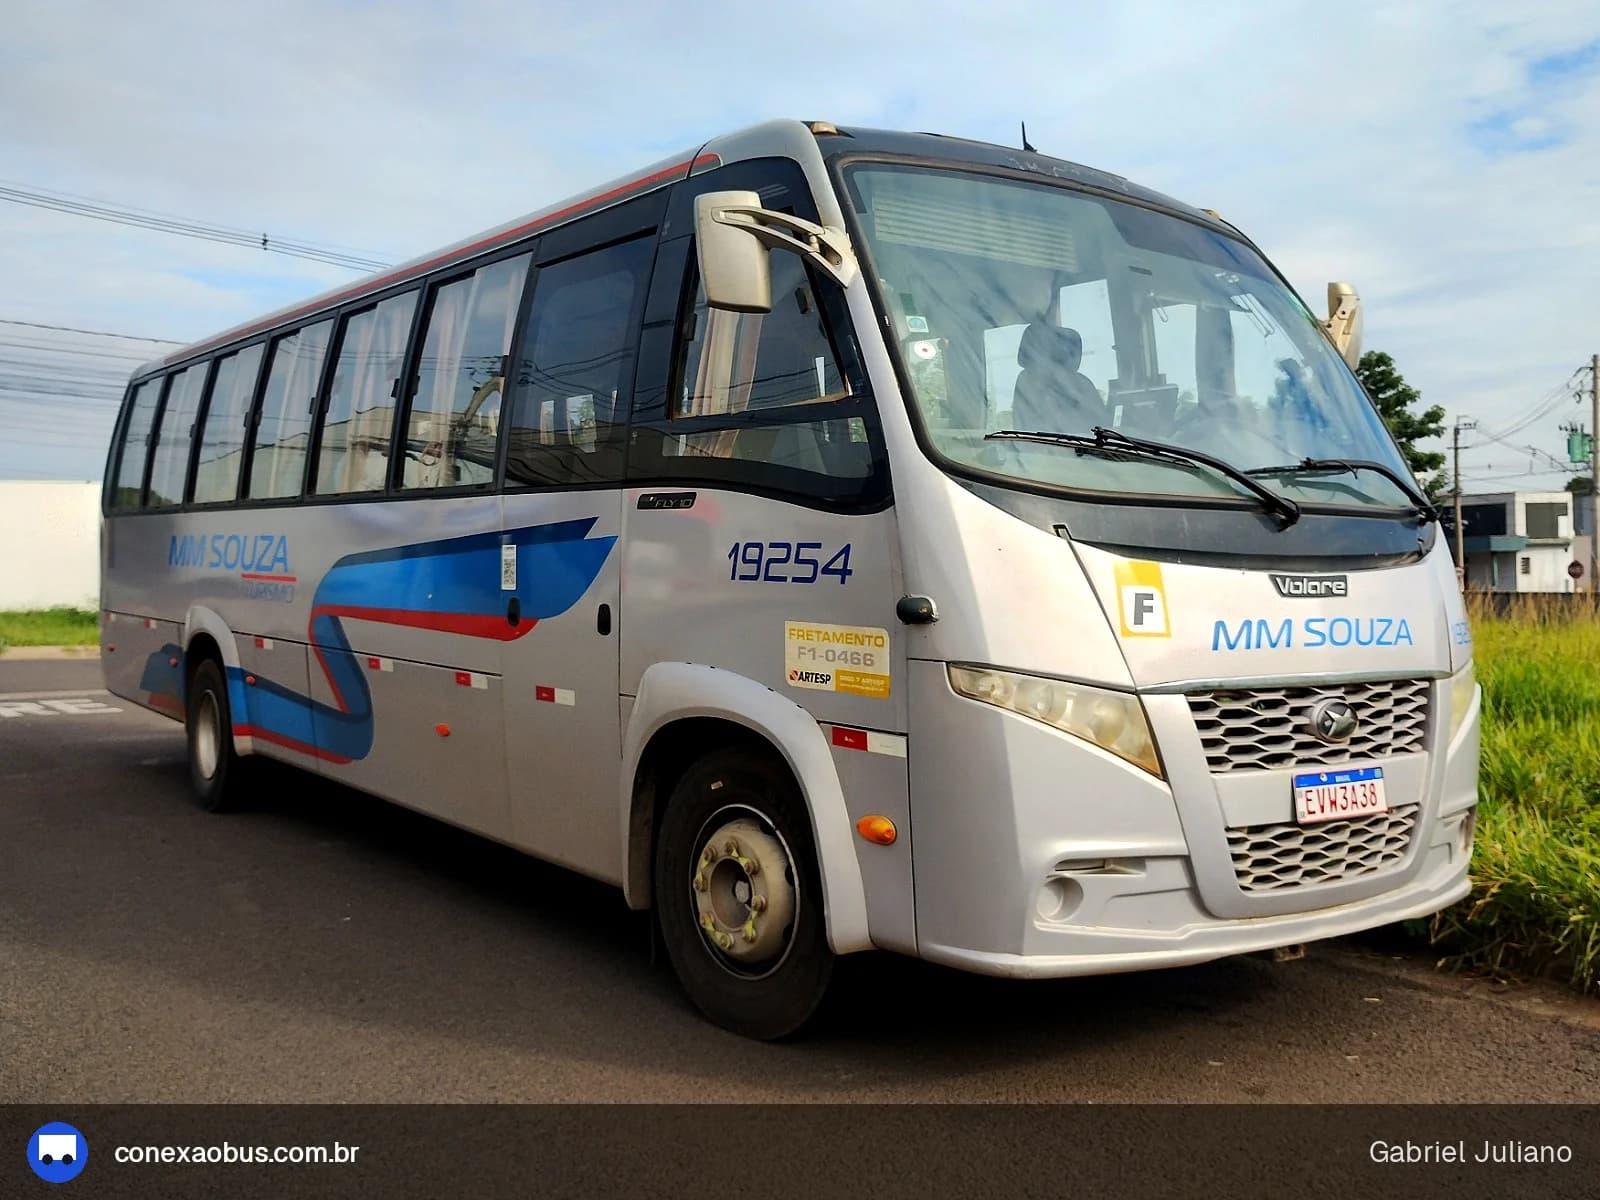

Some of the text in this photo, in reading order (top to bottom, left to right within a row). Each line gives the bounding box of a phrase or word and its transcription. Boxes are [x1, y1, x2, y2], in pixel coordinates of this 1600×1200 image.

[168, 534, 289, 573] MM SOUZA
[727, 542, 853, 585] 19254
[1275, 577, 1346, 595] Volare
[1133, 592, 1154, 625] F
[788, 628, 885, 648] FRETAMENTO
[1211, 617, 1413, 651] MM SOUZA
[797, 646, 875, 667] F1-0466
[798, 671, 831, 685] ARTESP
[1304, 783, 1378, 815] EVW3A38
